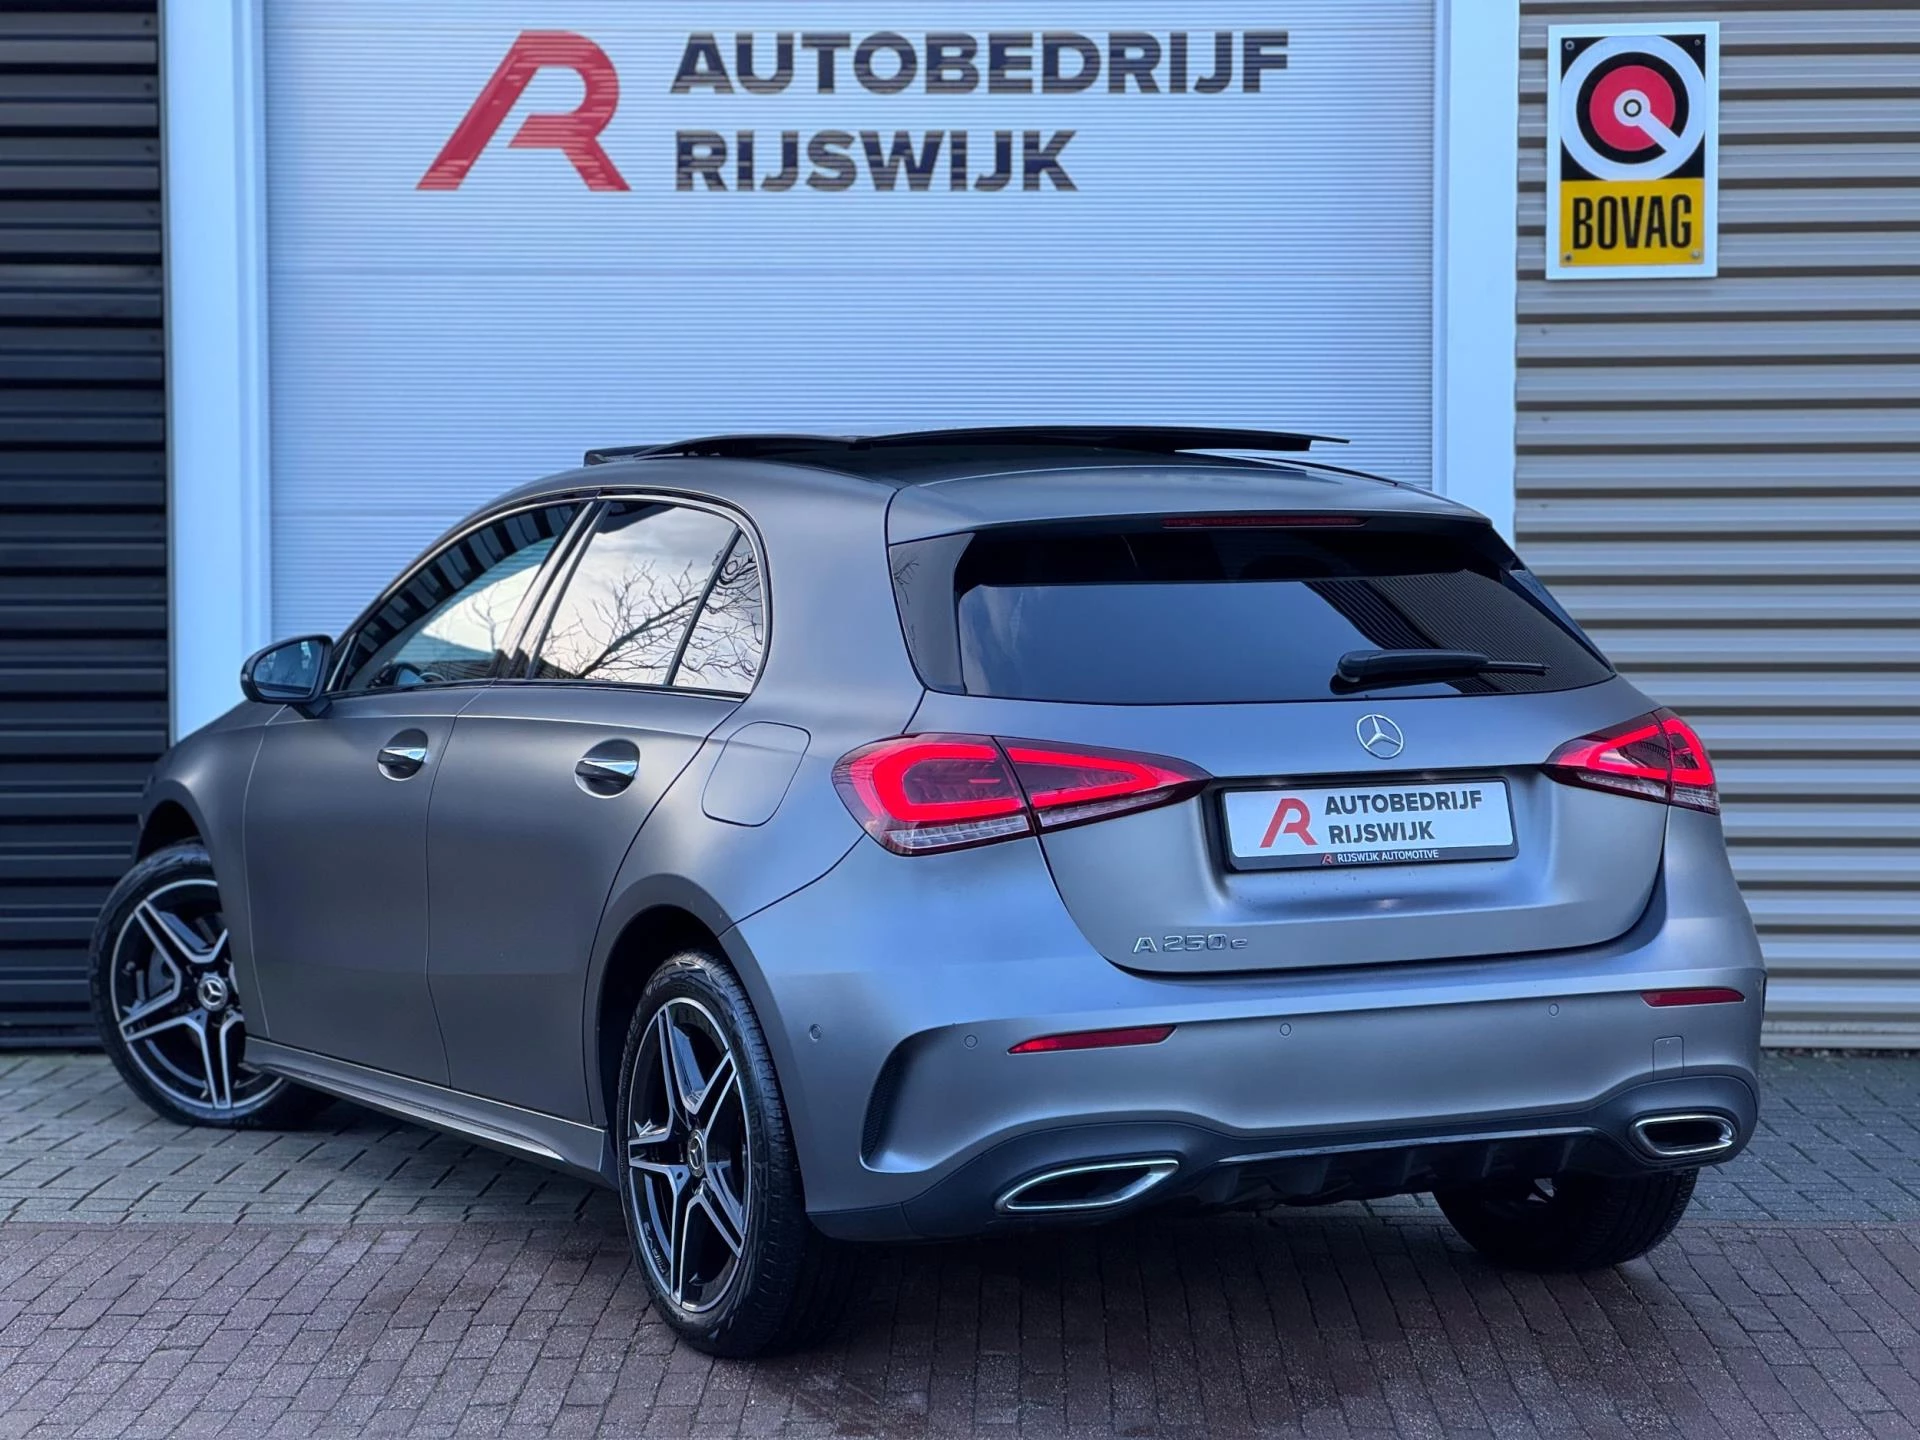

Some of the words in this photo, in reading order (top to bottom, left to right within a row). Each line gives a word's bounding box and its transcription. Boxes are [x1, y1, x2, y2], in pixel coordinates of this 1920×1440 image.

[669, 31, 1290, 96] AUTOBEDRIJF
[675, 130, 1078, 193] RIJSWIJK
[1571, 193, 1693, 251] BOVAG
[1324, 789, 1483, 816] AUTOBEDRIJF
[1328, 820, 1436, 845] RIJSWIJK
[1337, 852, 1380, 864] RIJSWIJK
[1381, 849, 1440, 862] AUTOMOTIVE
[1132, 936, 1158, 954] A
